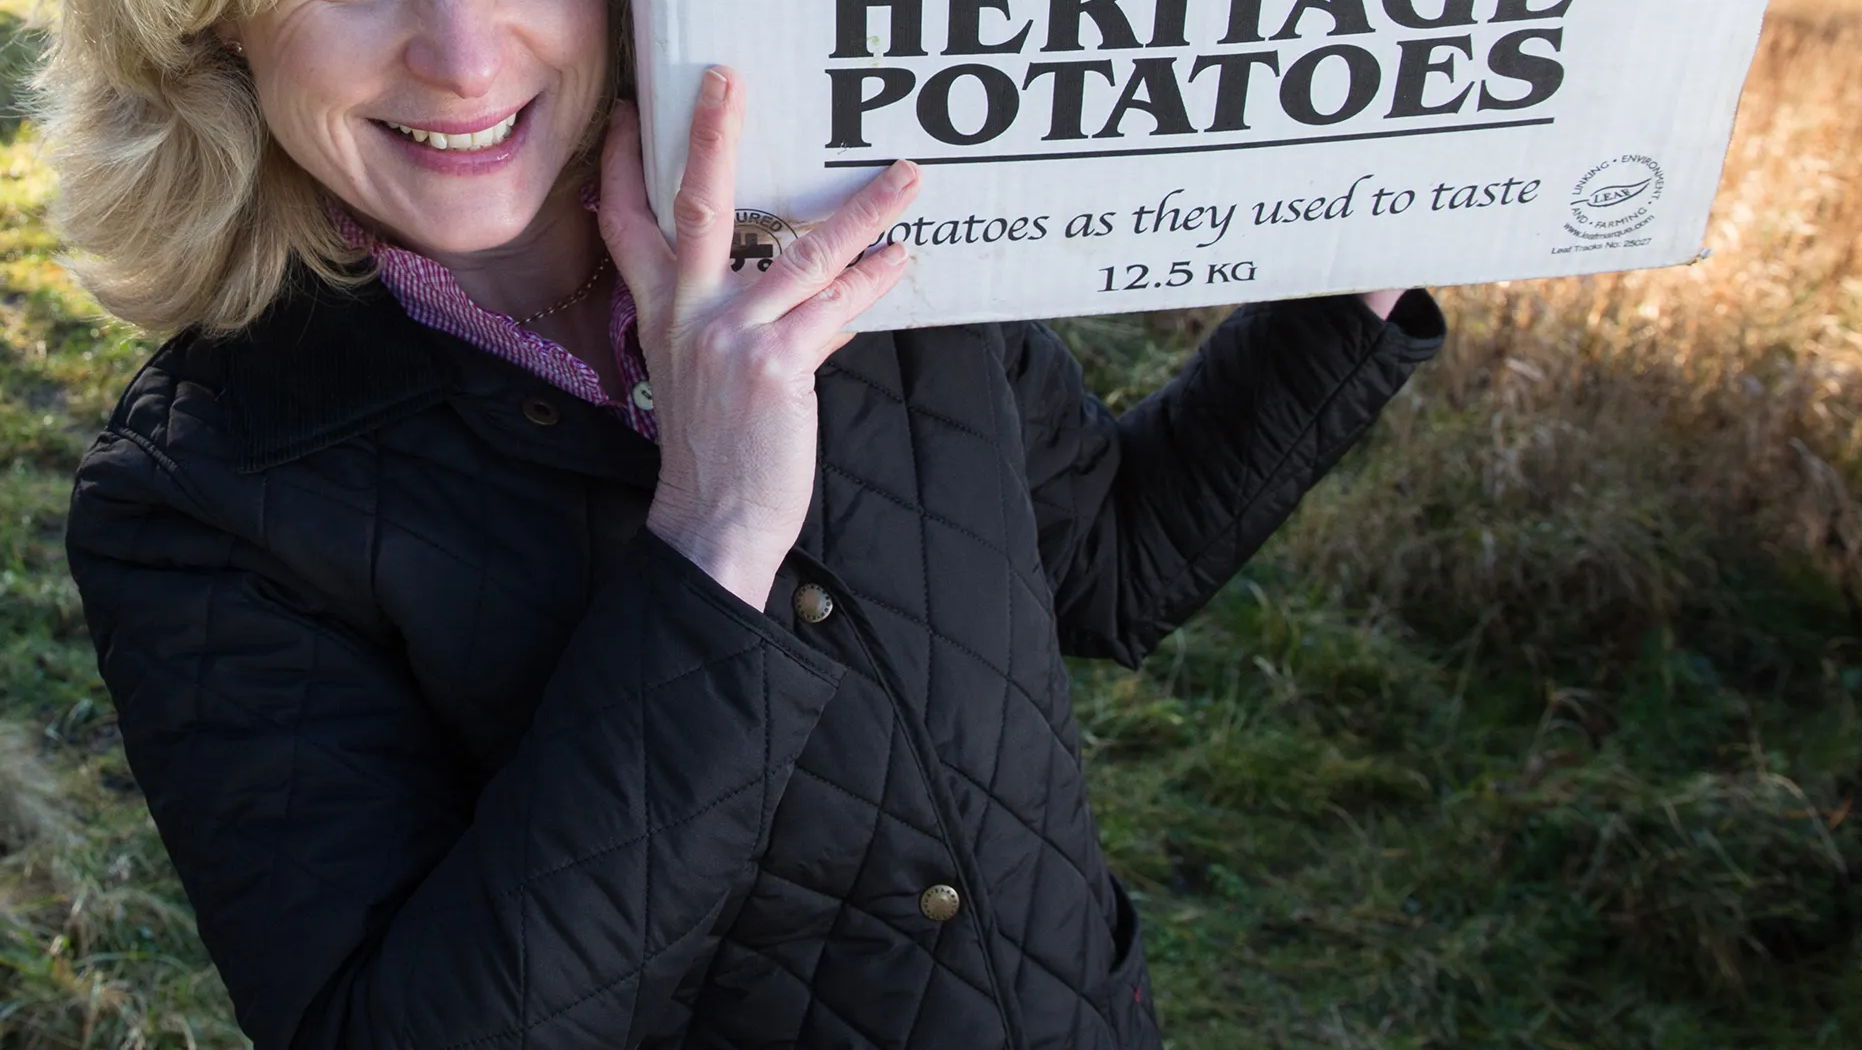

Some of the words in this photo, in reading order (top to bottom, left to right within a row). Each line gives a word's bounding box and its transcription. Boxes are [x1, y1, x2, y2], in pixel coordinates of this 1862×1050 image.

[824, 27, 1565, 149] POTATOES
[1572, 161, 1610, 196] LINKING
[1621, 154, 1665, 201] ENVIRONMENT
[1593, 188, 1631, 204] LEAF
[846, 214, 1050, 267] otatoes
[1064, 211, 1117, 239] as
[1131, 188, 1237, 248] they
[1252, 174, 1374, 226] used
[1371, 187, 1416, 216] to
[1431, 177, 1541, 211] taste
[1571, 207, 1589, 224] AND
[1594, 207, 1648, 229] FARMING
[1097, 260, 1194, 292] 12.5
[1206, 261, 1257, 284] KG
